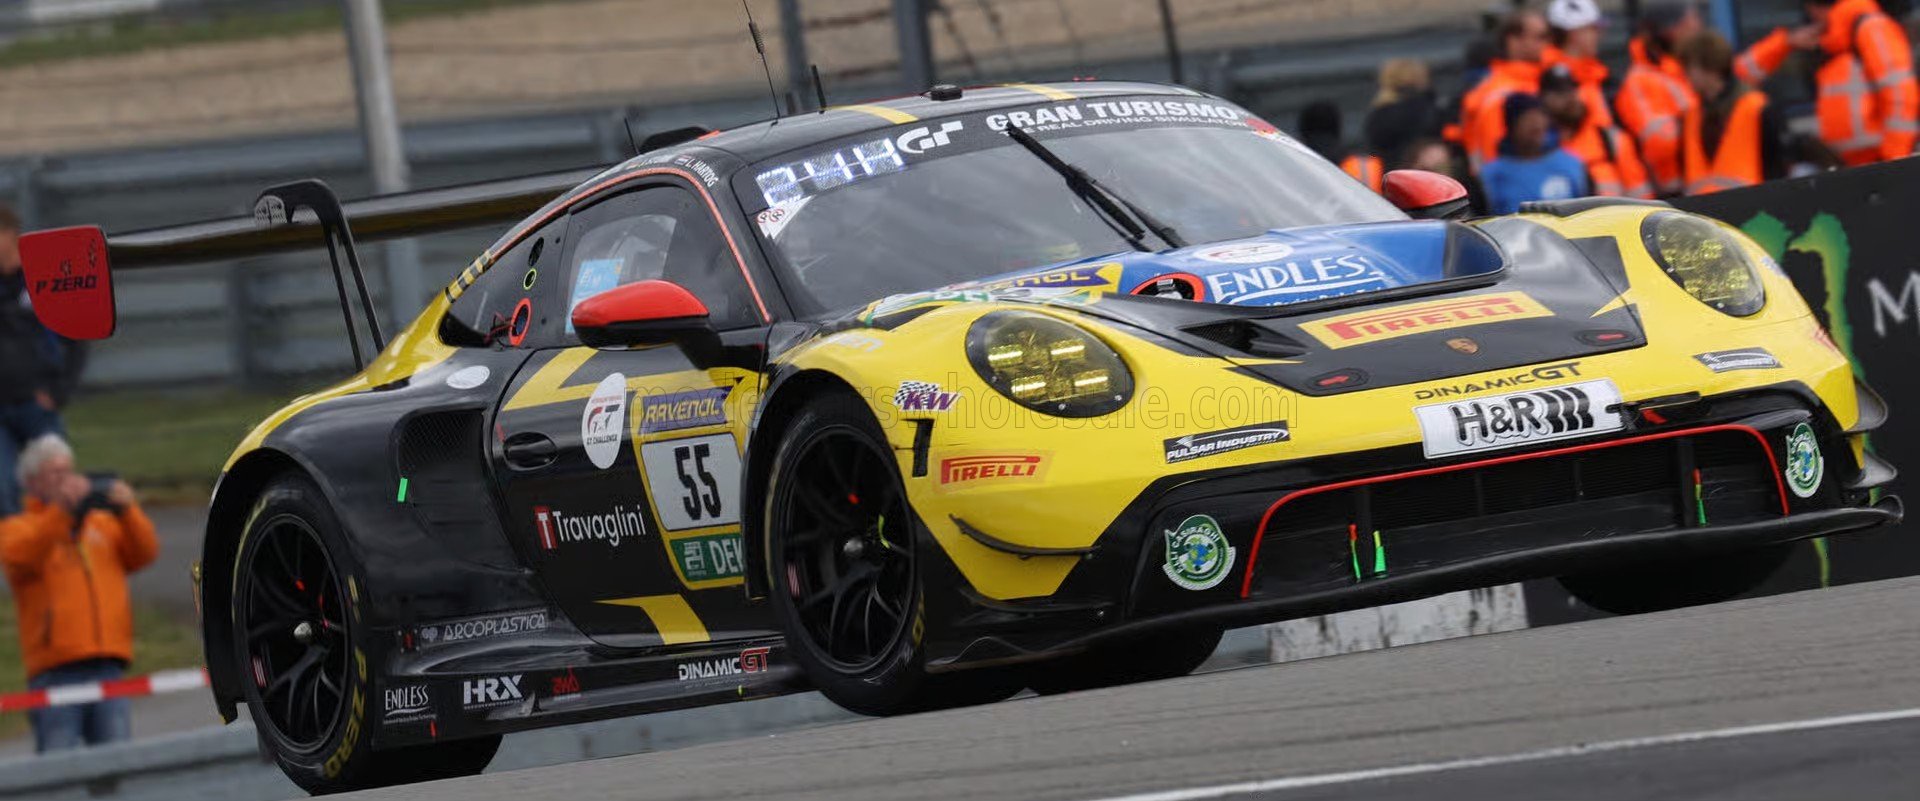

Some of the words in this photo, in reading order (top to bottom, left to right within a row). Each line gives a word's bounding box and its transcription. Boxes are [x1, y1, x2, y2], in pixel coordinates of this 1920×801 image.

[986, 105, 1083, 131] GRAN
[1086, 100, 1239, 121] TURISMO
[998, 126, 1036, 137] TE
[1037, 123, 1082, 132] REAL
[1084, 116, 1152, 127] DRIVING
[1154, 115, 1247, 128] SIMULATOR
[690, 160, 719, 188] HARTOG
[51, 275, 98, 293] ZERO
[1325, 297, 1526, 340] PIRELLI
[644, 397, 721, 424] RAVENOL
[1166, 440, 1215, 461] PULSAR
[1216, 431, 1281, 450] INDUSTRY
[674, 443, 722, 521] 55
[941, 455, 1041, 485] PIRELLI
[552, 505, 647, 548] Travaglini
[443, 613, 546, 641] ARCOPLASTICA
[385, 684, 430, 711] ENDLESS
[463, 672, 525, 705] HRX
